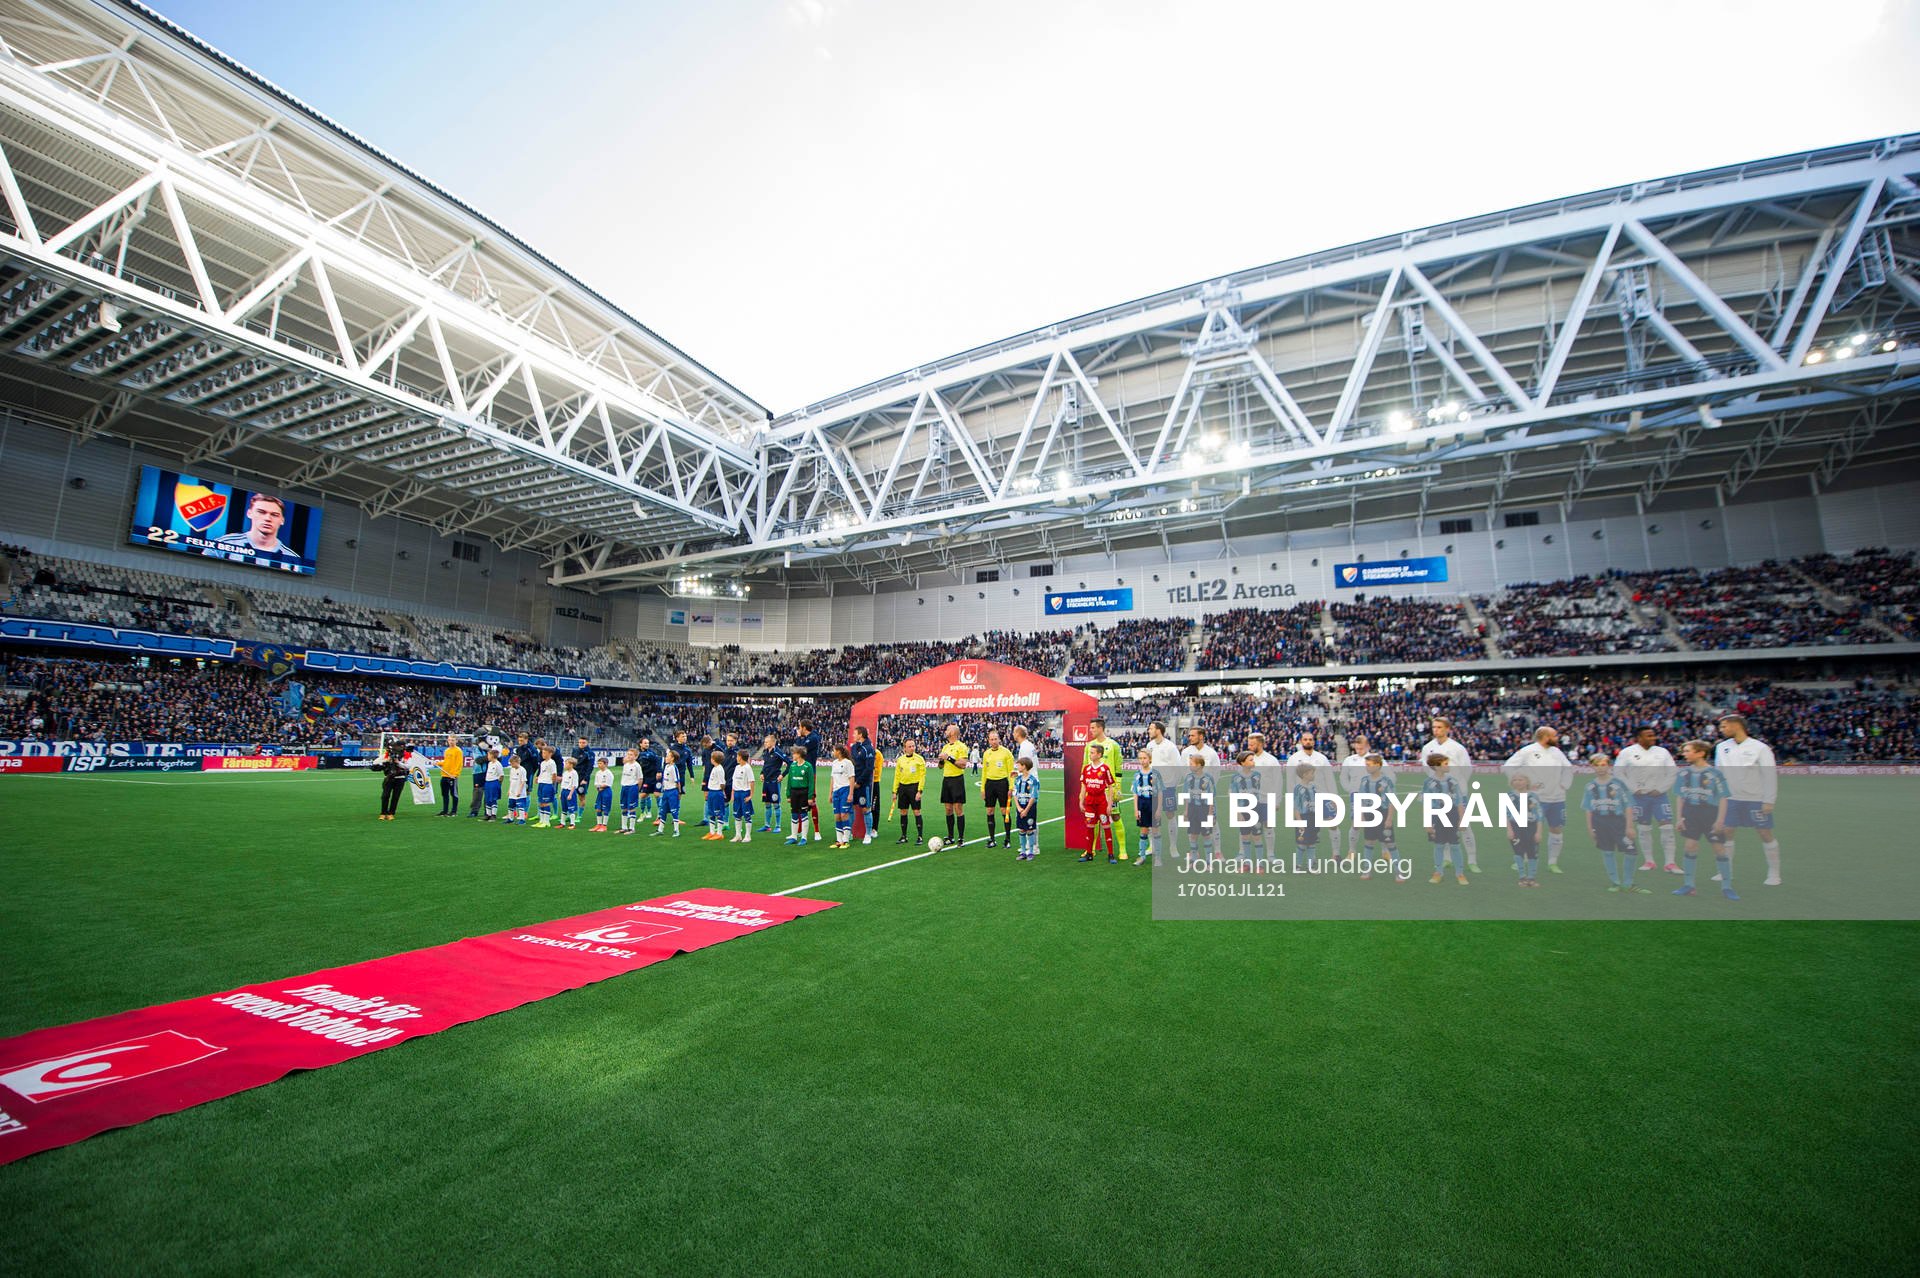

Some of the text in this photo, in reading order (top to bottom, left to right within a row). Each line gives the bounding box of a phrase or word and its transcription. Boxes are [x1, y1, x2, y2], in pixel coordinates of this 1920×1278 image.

[185, 497, 221, 515] D.I.F.
[147, 526, 180, 545] 22
[185, 536, 216, 549] FELIX
[1166, 578, 1297, 604] TELE2 Arena
[555, 607, 579, 618] TELE2
[900, 692, 1040, 710] Framåt för svensk fotboll!
[67, 756, 107, 772] ISP
[109, 759, 135, 768] Let's
[156, 759, 196, 771] together
[222, 757, 272, 769] Färingsö
[511, 934, 637, 959] SVENSKA SPEL
